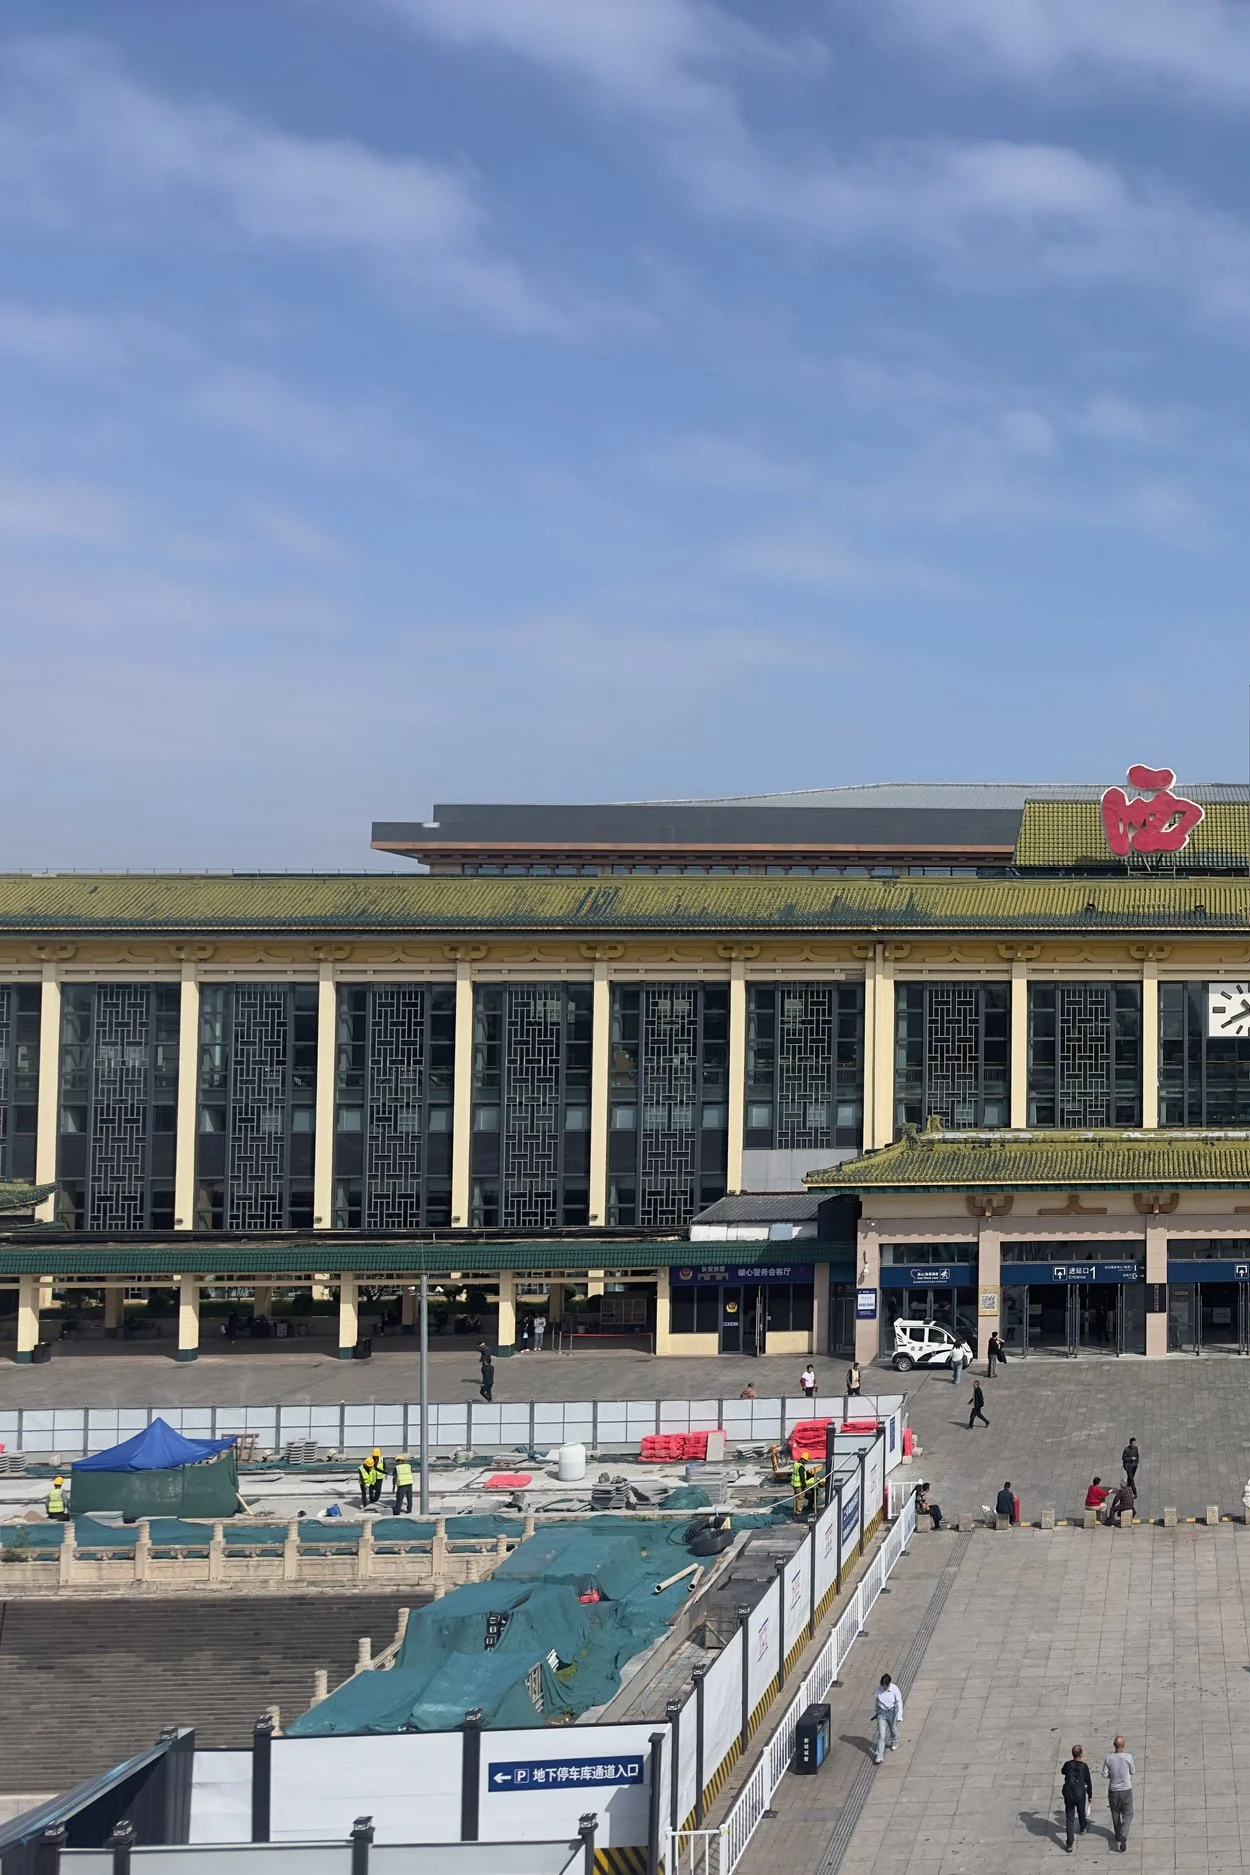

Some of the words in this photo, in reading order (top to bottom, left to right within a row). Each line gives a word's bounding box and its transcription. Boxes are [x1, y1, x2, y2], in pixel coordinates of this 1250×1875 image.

[532, 1763, 639, 1783] 地下停车库通道入口
